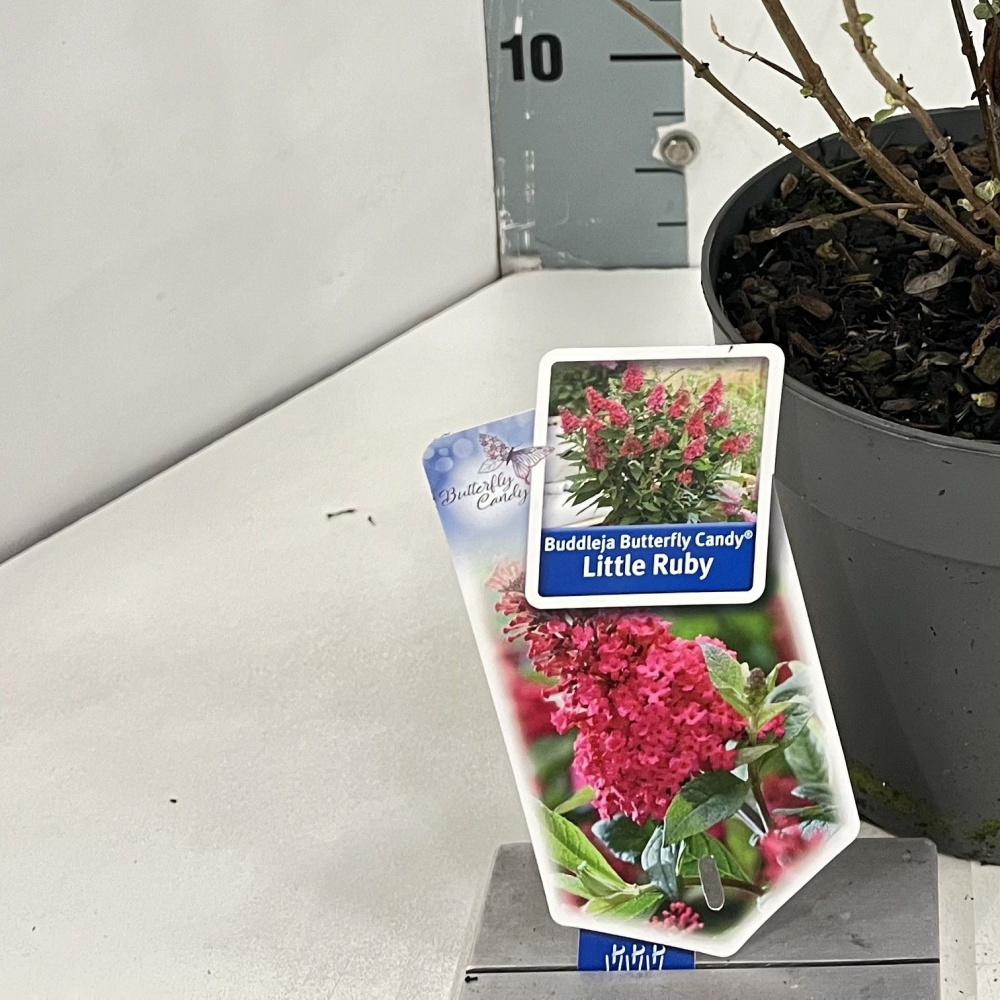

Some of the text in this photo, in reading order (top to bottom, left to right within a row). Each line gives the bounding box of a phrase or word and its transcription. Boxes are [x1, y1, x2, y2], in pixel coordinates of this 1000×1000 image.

[500, 33, 563, 83] 10
[439, 471, 514, 506] Butterfly
[477, 484, 529, 510] Candy
[544, 535, 615, 553] Buddleja
[620, 532, 691, 551] Butterfly
[583, 552, 714, 580] Little Ruby
